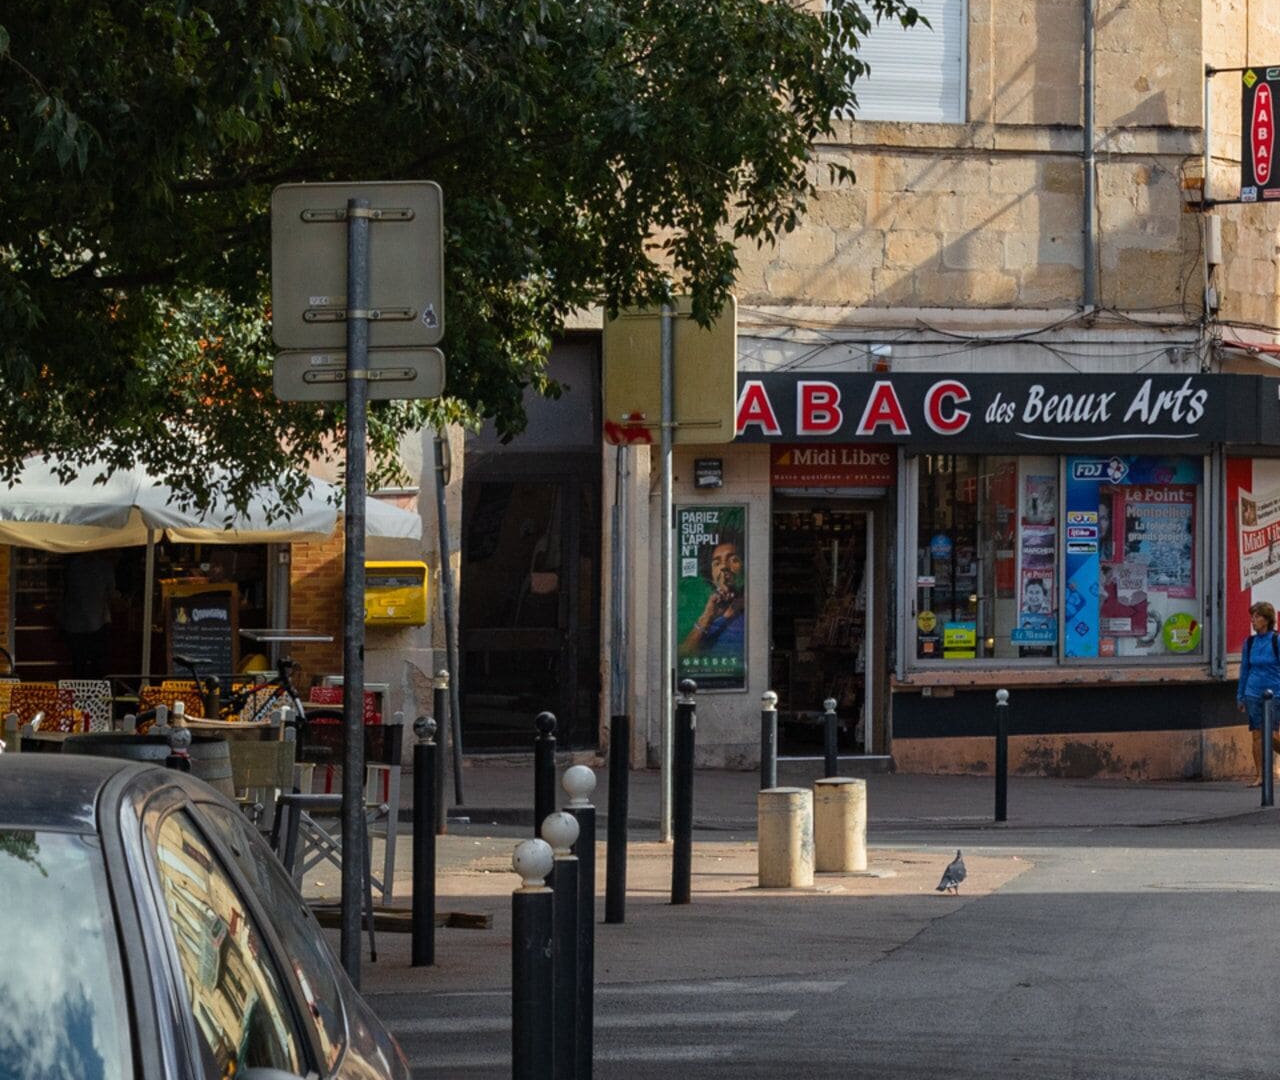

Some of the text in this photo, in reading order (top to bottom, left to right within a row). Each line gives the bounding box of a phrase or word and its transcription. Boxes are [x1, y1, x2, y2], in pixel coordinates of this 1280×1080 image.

[1257, 90, 1268, 176] TABAC
[735, 376, 1208, 436] ABAC des Beaux Arts
[793, 448, 890, 465] Midi Libre
[1076, 464, 1103, 476] FDJ
[1125, 489, 1185, 501] Le Point
[681, 512, 719, 523] PARIEZ
[1126, 505, 1192, 518] Montpellier
[681, 523, 704, 534] SUR
[1135, 521, 1145, 530] La
[681, 534, 719, 545] L'APPLI
[1128, 532, 1158, 543] grands
[1243, 529, 1266, 553] Midi
